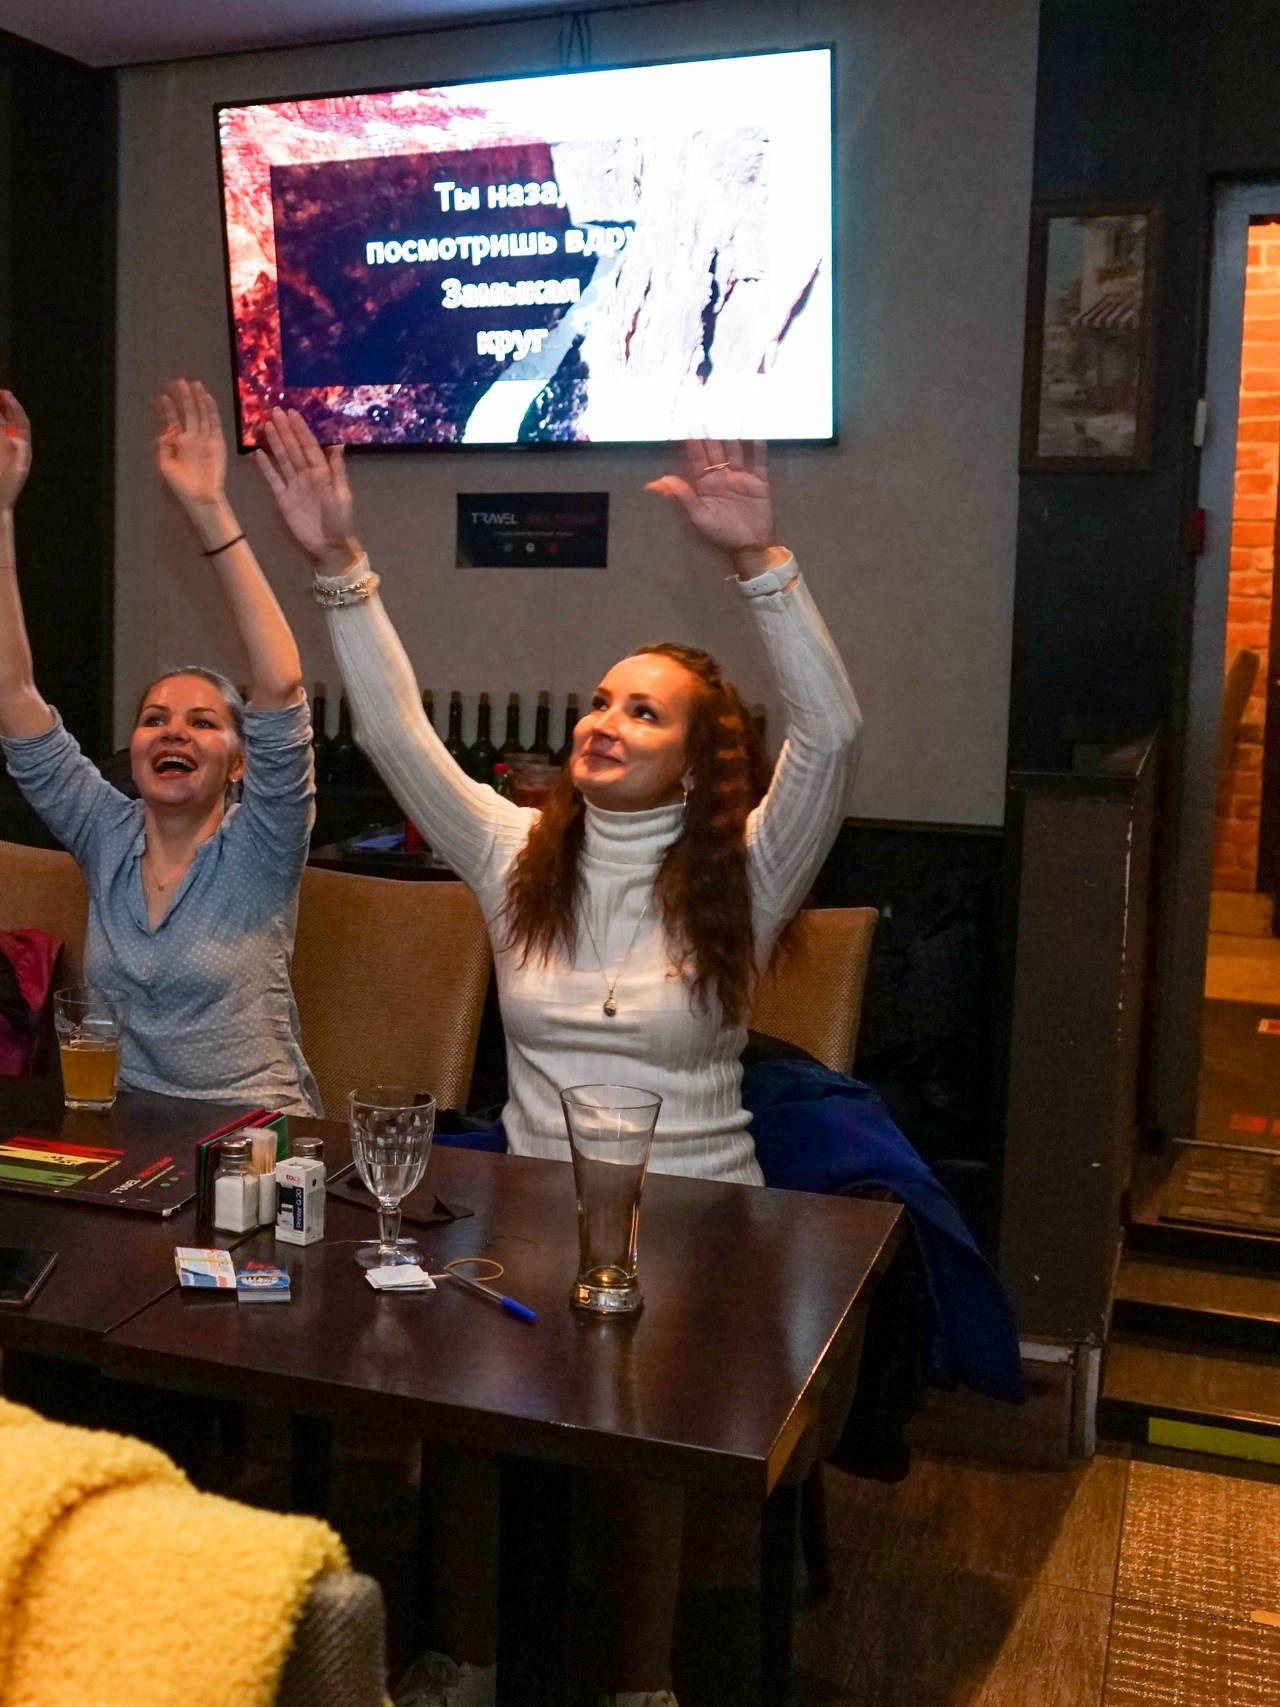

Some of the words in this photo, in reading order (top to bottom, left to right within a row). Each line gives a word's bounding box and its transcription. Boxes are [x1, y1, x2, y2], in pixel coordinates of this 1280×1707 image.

[433, 181, 480, 212] Ты
[366, 231, 558, 266] посмотришь
[476, 328, 549, 361] круг
[471, 512, 518, 525] TRAVEL
[295, 1188, 302, 1198] 20
